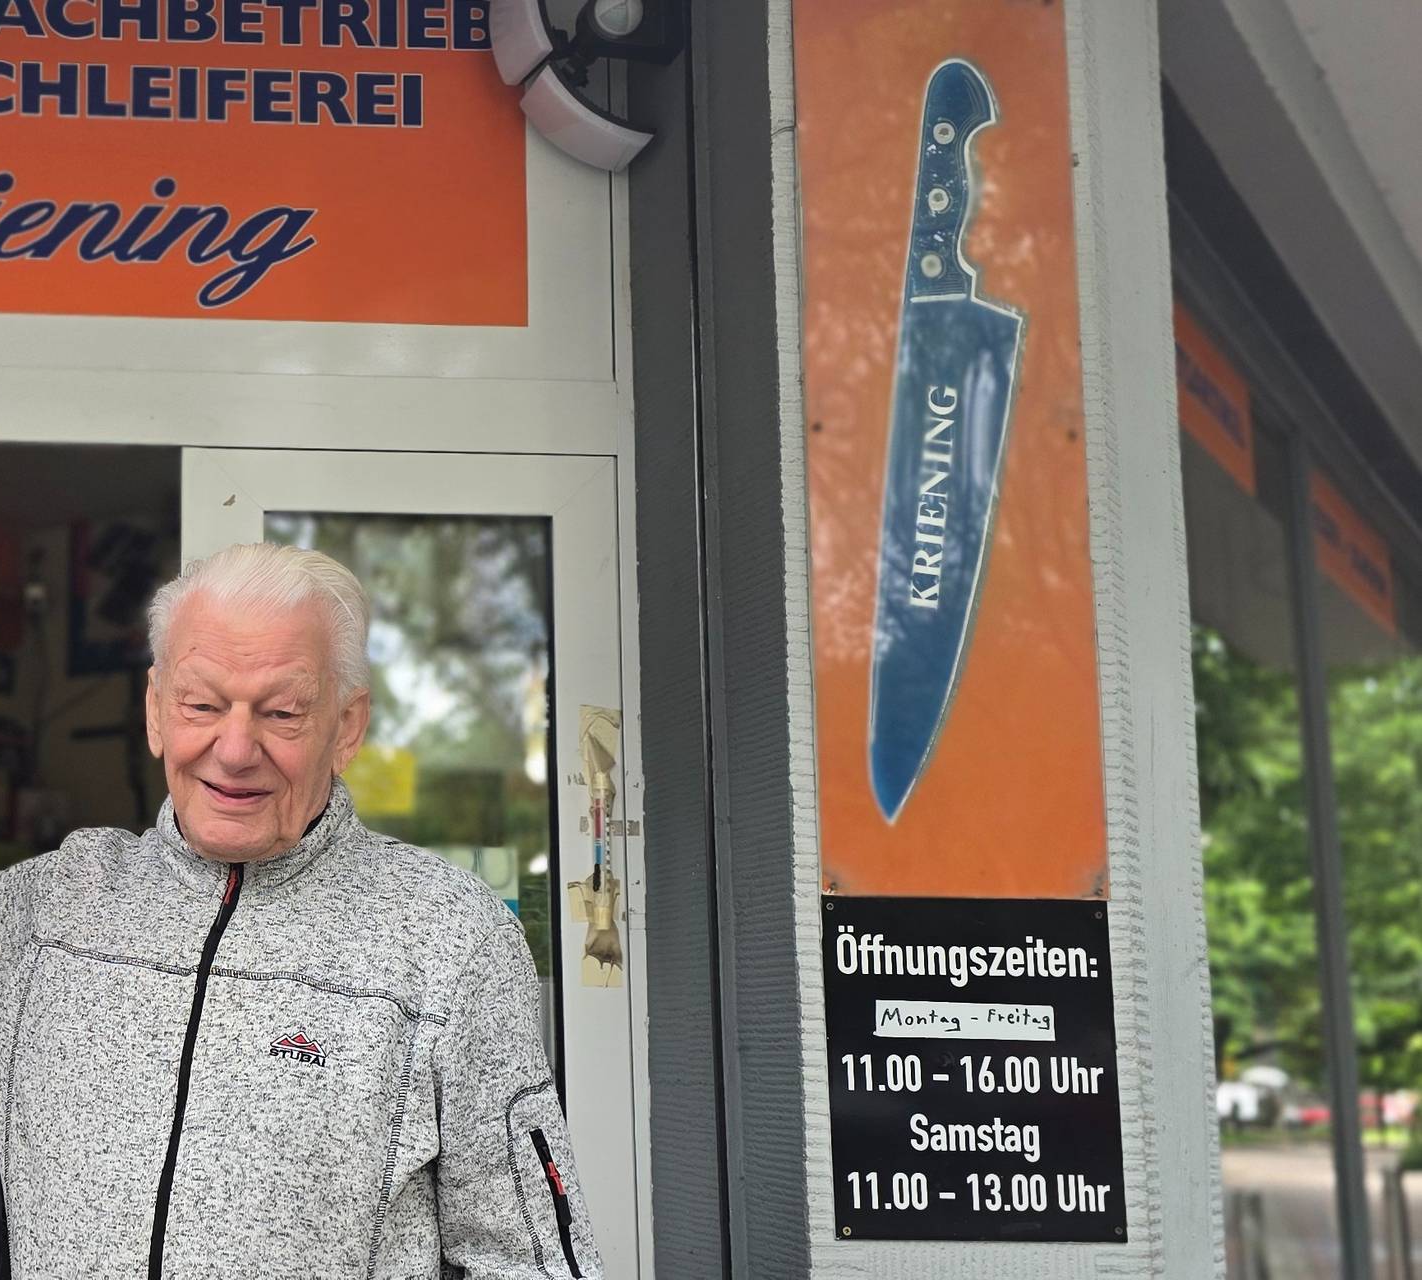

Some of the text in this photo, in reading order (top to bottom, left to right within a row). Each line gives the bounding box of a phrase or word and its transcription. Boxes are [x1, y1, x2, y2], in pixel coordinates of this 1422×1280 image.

[909, 384, 958, 609] KRIENING
[837, 925, 1098, 987] Öffnungszeiten:
[880, 1008, 960, 1031] Montag
[988, 1008, 1050, 1029] Freitag
[269, 1048, 326, 1067] STUBAI
[841, 1054, 922, 1092] 11.00
[959, 1055, 1040, 1093] 16.00
[1050, 1056, 1104, 1093] Uhr
[910, 1114, 1040, 1162] Samstag
[847, 1172, 928, 1210] 11.00
[966, 1173, 1047, 1212] 13.00
[1057, 1174, 1110, 1212] Uhr
